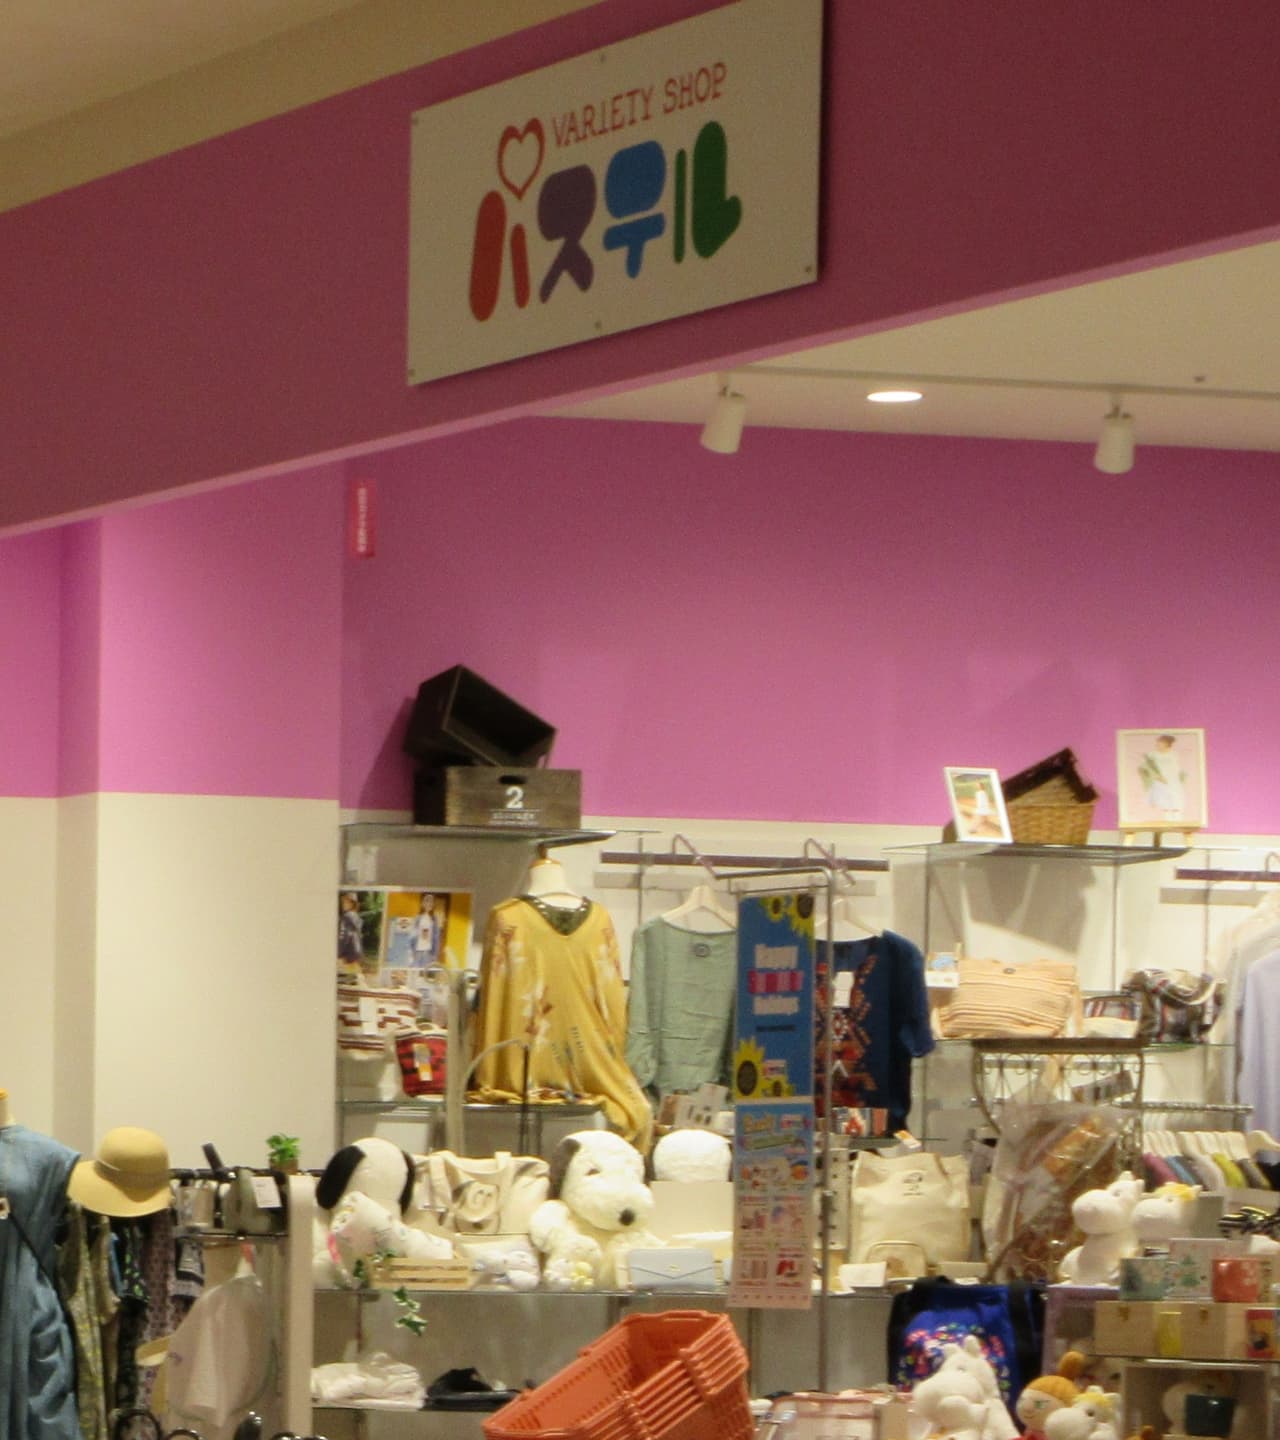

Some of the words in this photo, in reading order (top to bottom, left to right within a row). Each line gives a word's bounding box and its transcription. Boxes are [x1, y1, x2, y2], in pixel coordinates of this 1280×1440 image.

[552, 86, 654, 148] VARIETY
[662, 61, 728, 116] SHOP
[469, 117, 743, 323] パステル
[505, 786, 524, 809] 2
